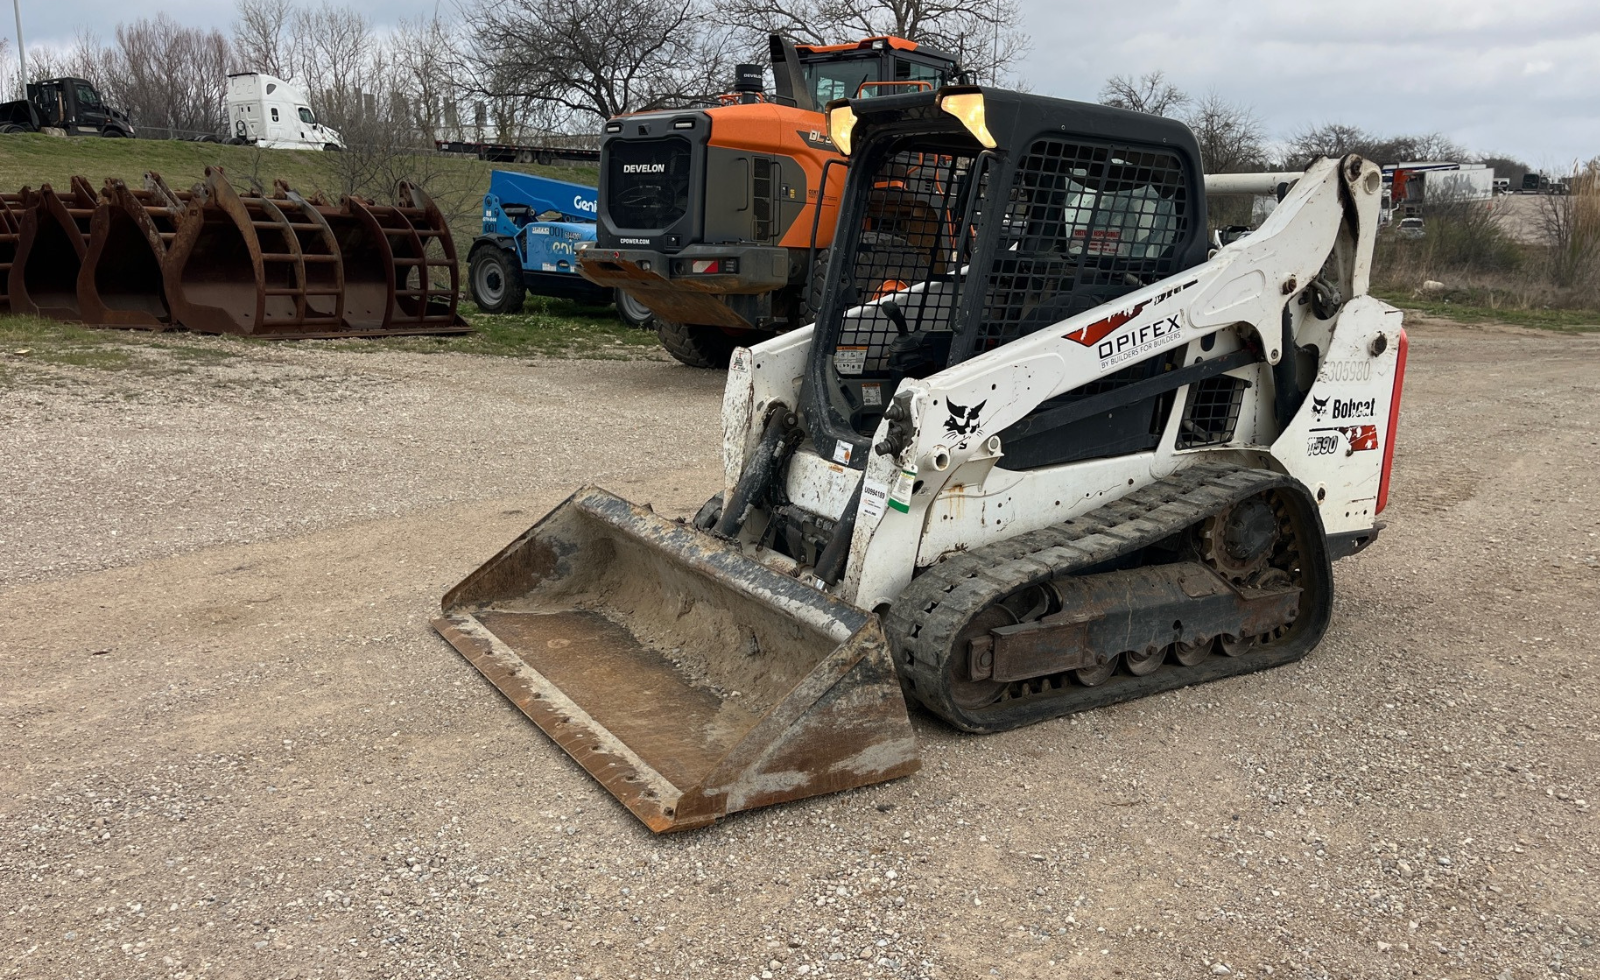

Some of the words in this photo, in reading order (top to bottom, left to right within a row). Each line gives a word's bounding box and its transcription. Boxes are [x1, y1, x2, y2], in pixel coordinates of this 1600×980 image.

[623, 164, 665, 173] DEVELON
[573, 195, 598, 213] Geni
[550, 226, 564, 239] 001
[1098, 314, 1180, 359] OPIFEX
[1101, 361, 1109, 369] BY
[1110, 348, 1139, 365] BUILDERS
[1140, 343, 1153, 353] FOR
[1153, 332, 1181, 348] BUILDERS
[1332, 397, 1376, 419] Bobcat
